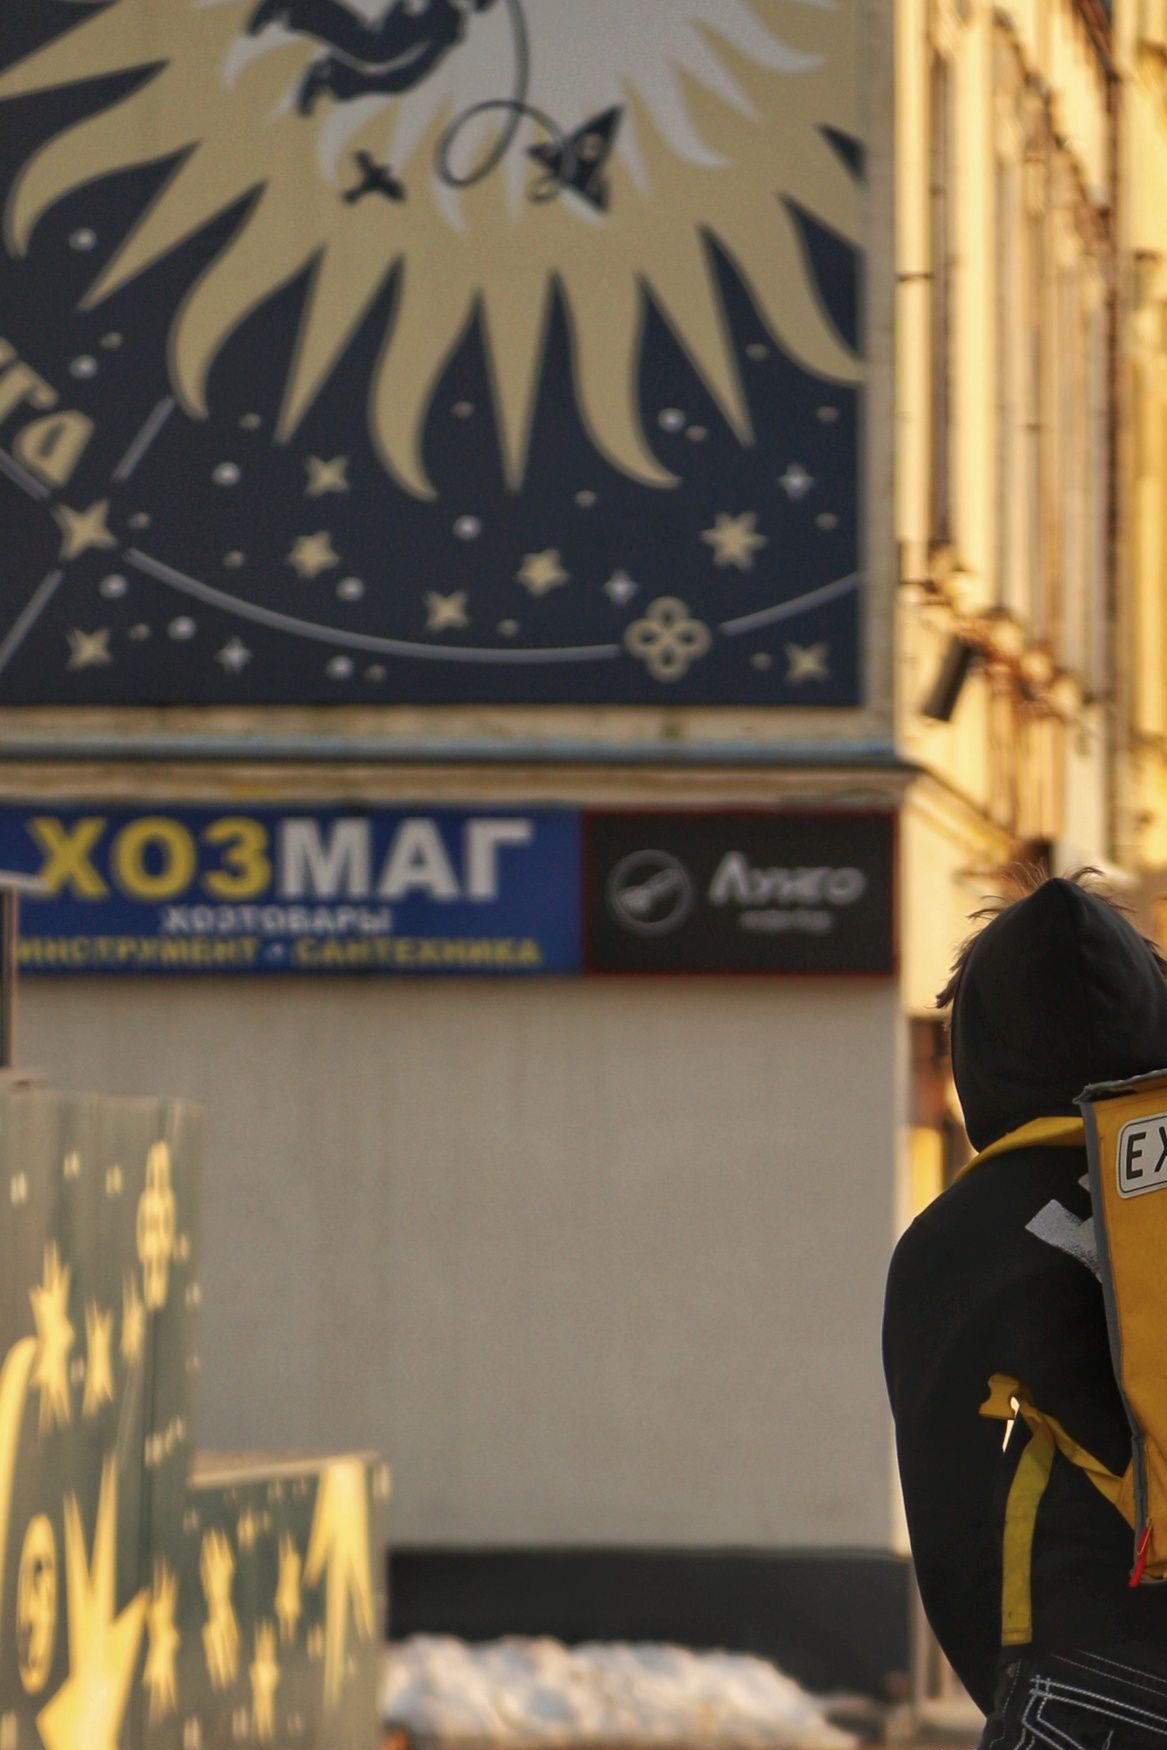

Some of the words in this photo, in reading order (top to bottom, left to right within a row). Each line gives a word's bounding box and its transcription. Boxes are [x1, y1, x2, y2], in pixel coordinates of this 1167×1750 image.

[28, 817, 531, 899] ХОЗМАГ
[162, 904, 392, 934] ХОЗТОВАРЫ
[293, 938, 543, 968] САНТЕХНИКА
